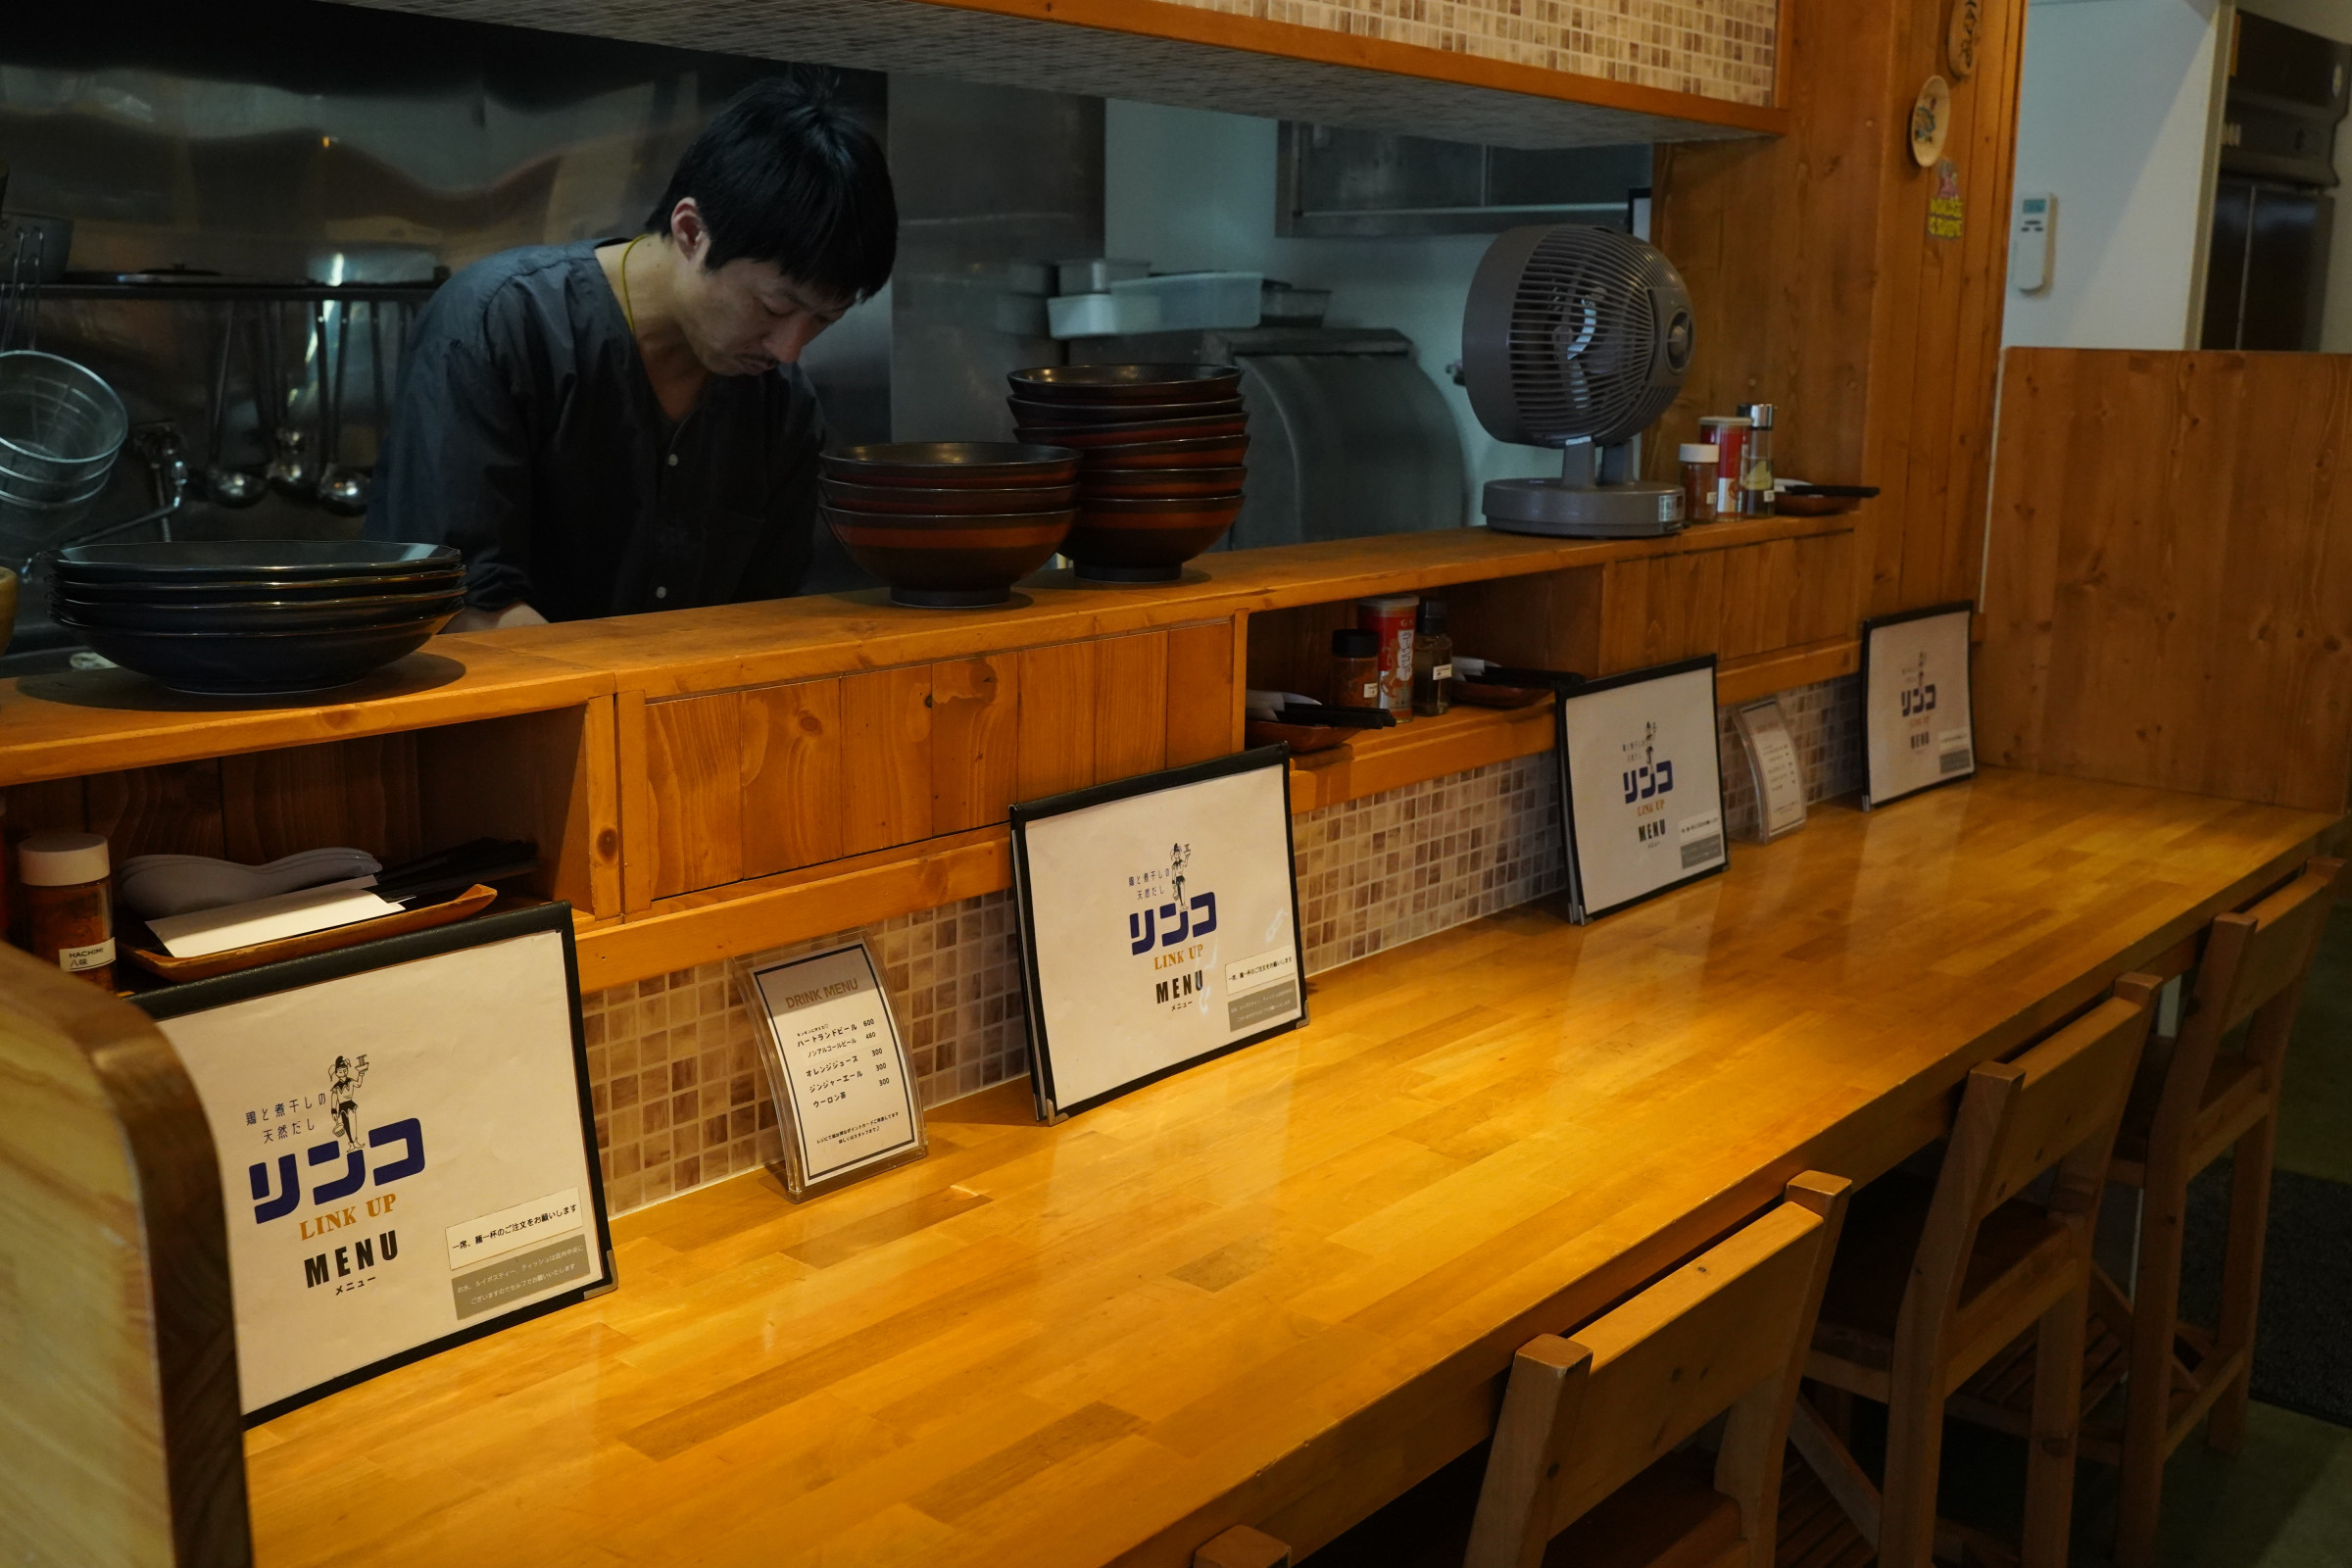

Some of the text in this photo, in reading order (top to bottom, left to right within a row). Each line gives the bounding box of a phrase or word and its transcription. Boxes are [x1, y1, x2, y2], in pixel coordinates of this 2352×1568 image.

[1622, 760, 1674, 805] リンコ
[1639, 819, 1665, 842] MENU
[1129, 891, 1217, 956] リンコ
[69, 947, 104, 958] HACHIMI
[1153, 944, 1203, 971] LINK UP
[785, 978, 858, 1009] DRINK MENU
[1155, 969, 1203, 1004] MENU
[1171, 1001, 1193, 1011] メニュー
[797, 1023, 858, 1048] ハートランドビール
[808, 1038, 857, 1058] ノンアルコールビール
[806, 1048, 883, 1077] オレンジジュース 300
[809, 1062, 887, 1093] ジンジャーエール 300
[812, 1077, 890, 1108] ウーロン茶 300
[246, 1093, 326, 1126] 鶏と煮干しの
[263, 1118, 315, 1144] 天然だし
[249, 1117, 425, 1224] リンコ
[299, 1193, 397, 1241] LINK UP
[304, 1230, 399, 1288] MENU
[335, 1276, 376, 1296] メニュー
